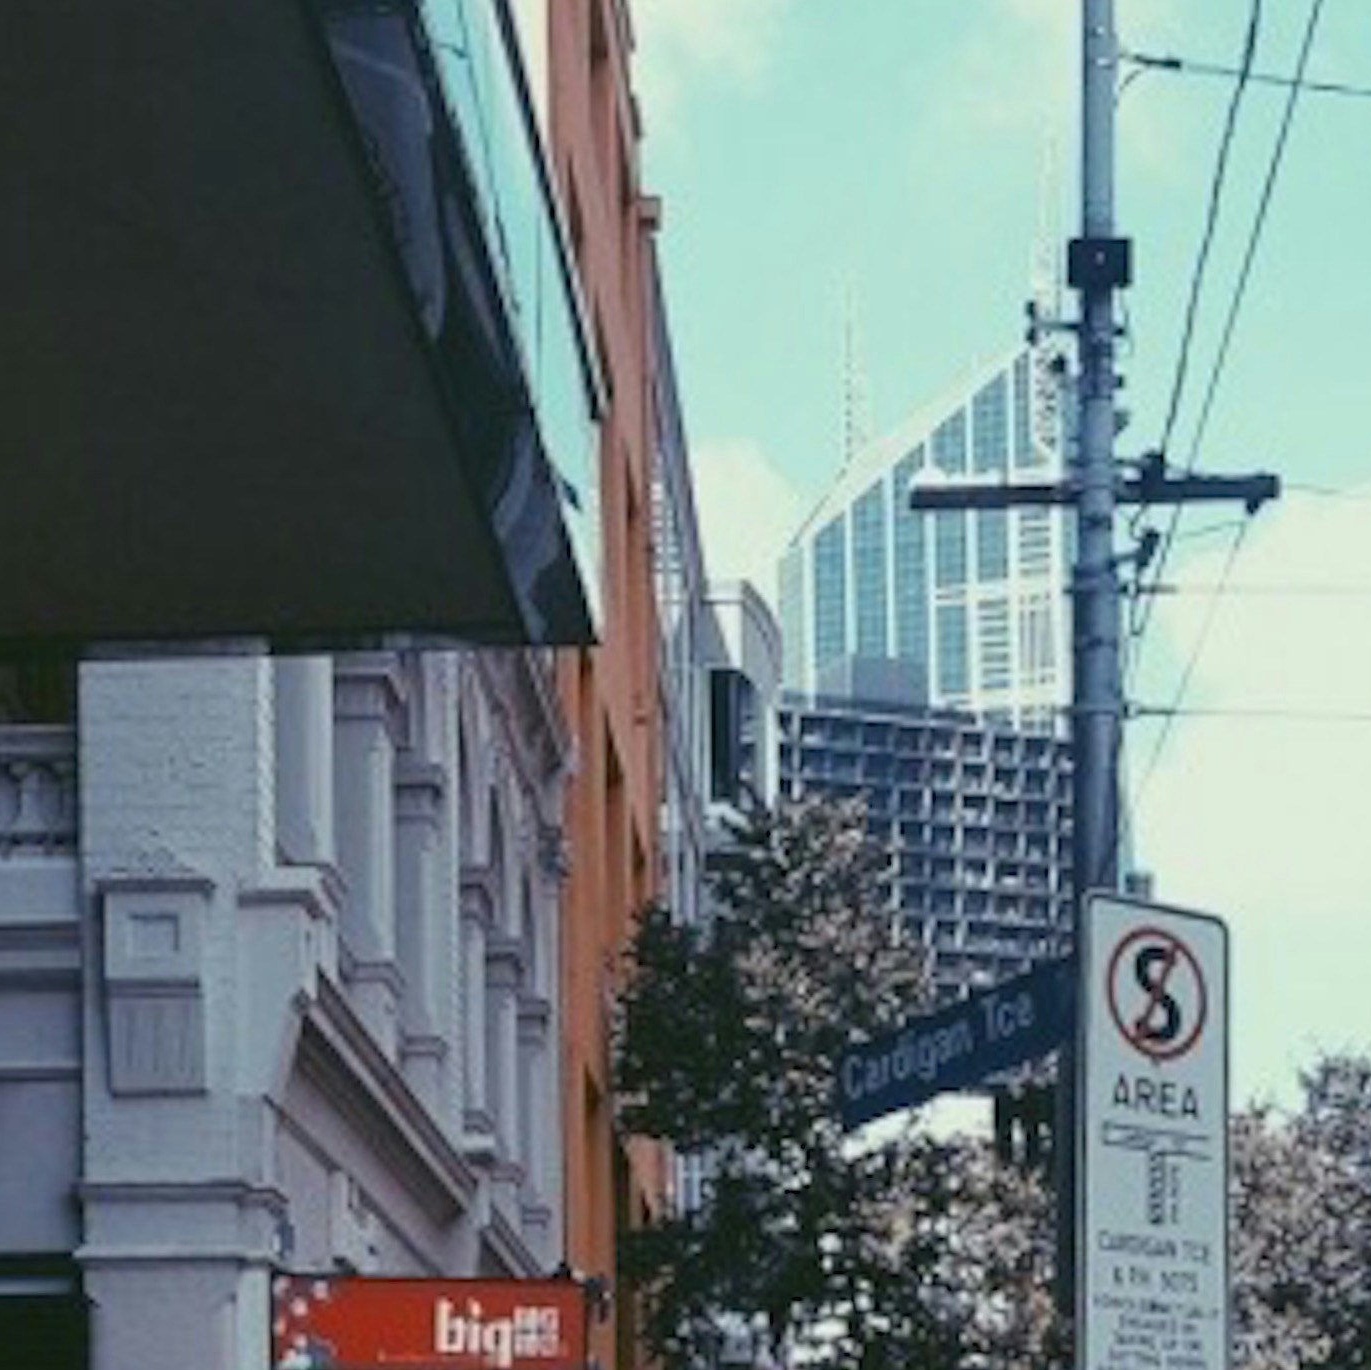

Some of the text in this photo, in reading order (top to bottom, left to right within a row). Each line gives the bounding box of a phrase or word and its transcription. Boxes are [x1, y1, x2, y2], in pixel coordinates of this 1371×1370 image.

[841, 992, 1035, 1101] Cardigan Tce
[1113, 1073, 1198, 1119] AREA
[435, 1297, 513, 1369] big
